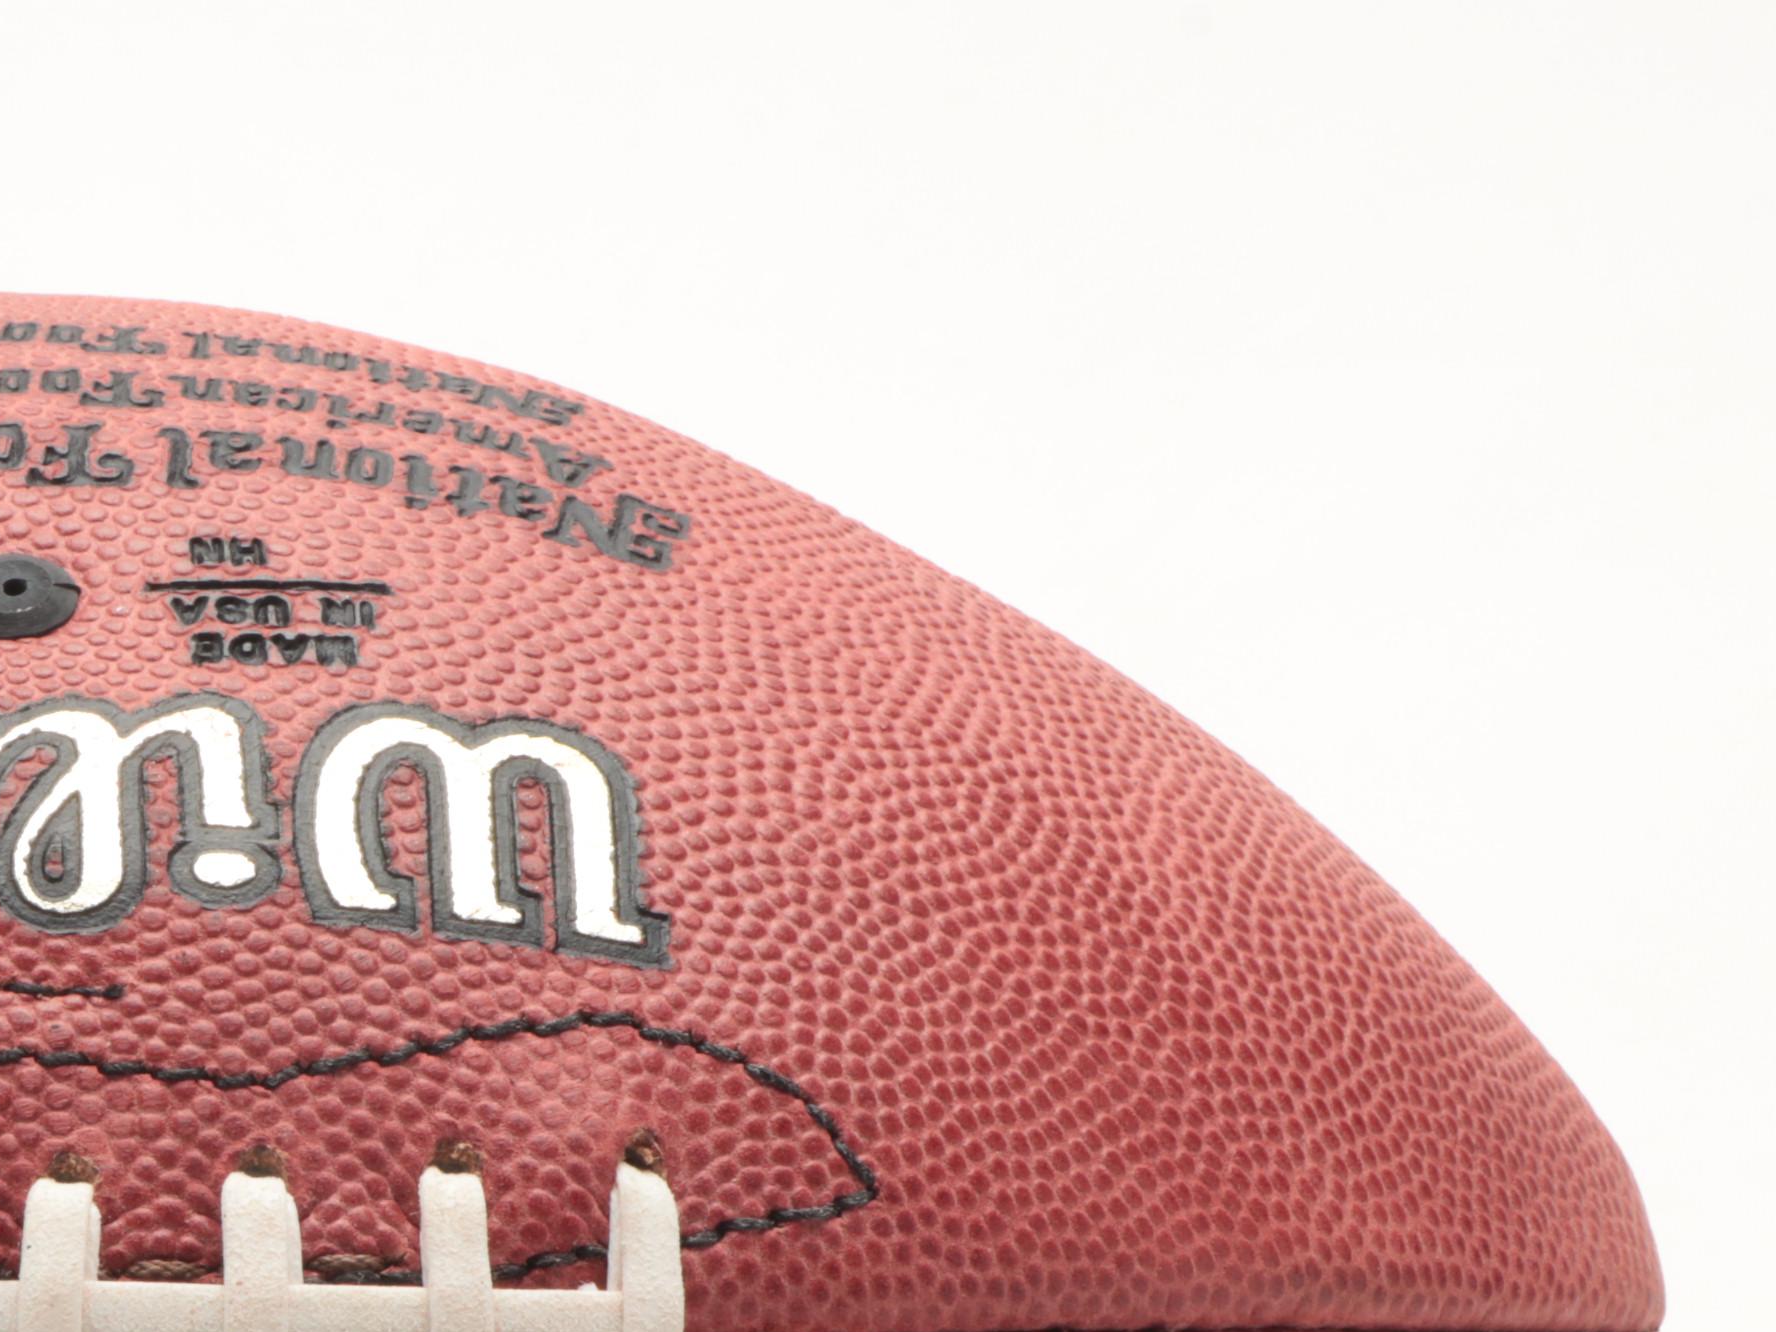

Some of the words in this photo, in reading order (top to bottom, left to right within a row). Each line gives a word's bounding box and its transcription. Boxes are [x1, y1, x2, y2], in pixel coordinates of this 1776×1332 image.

[174, 330, 582, 426] National
[167, 373, 614, 488] American
[157, 426, 691, 572] National
[168, 595, 292, 629] USA
[190, 632, 360, 667] MADE
